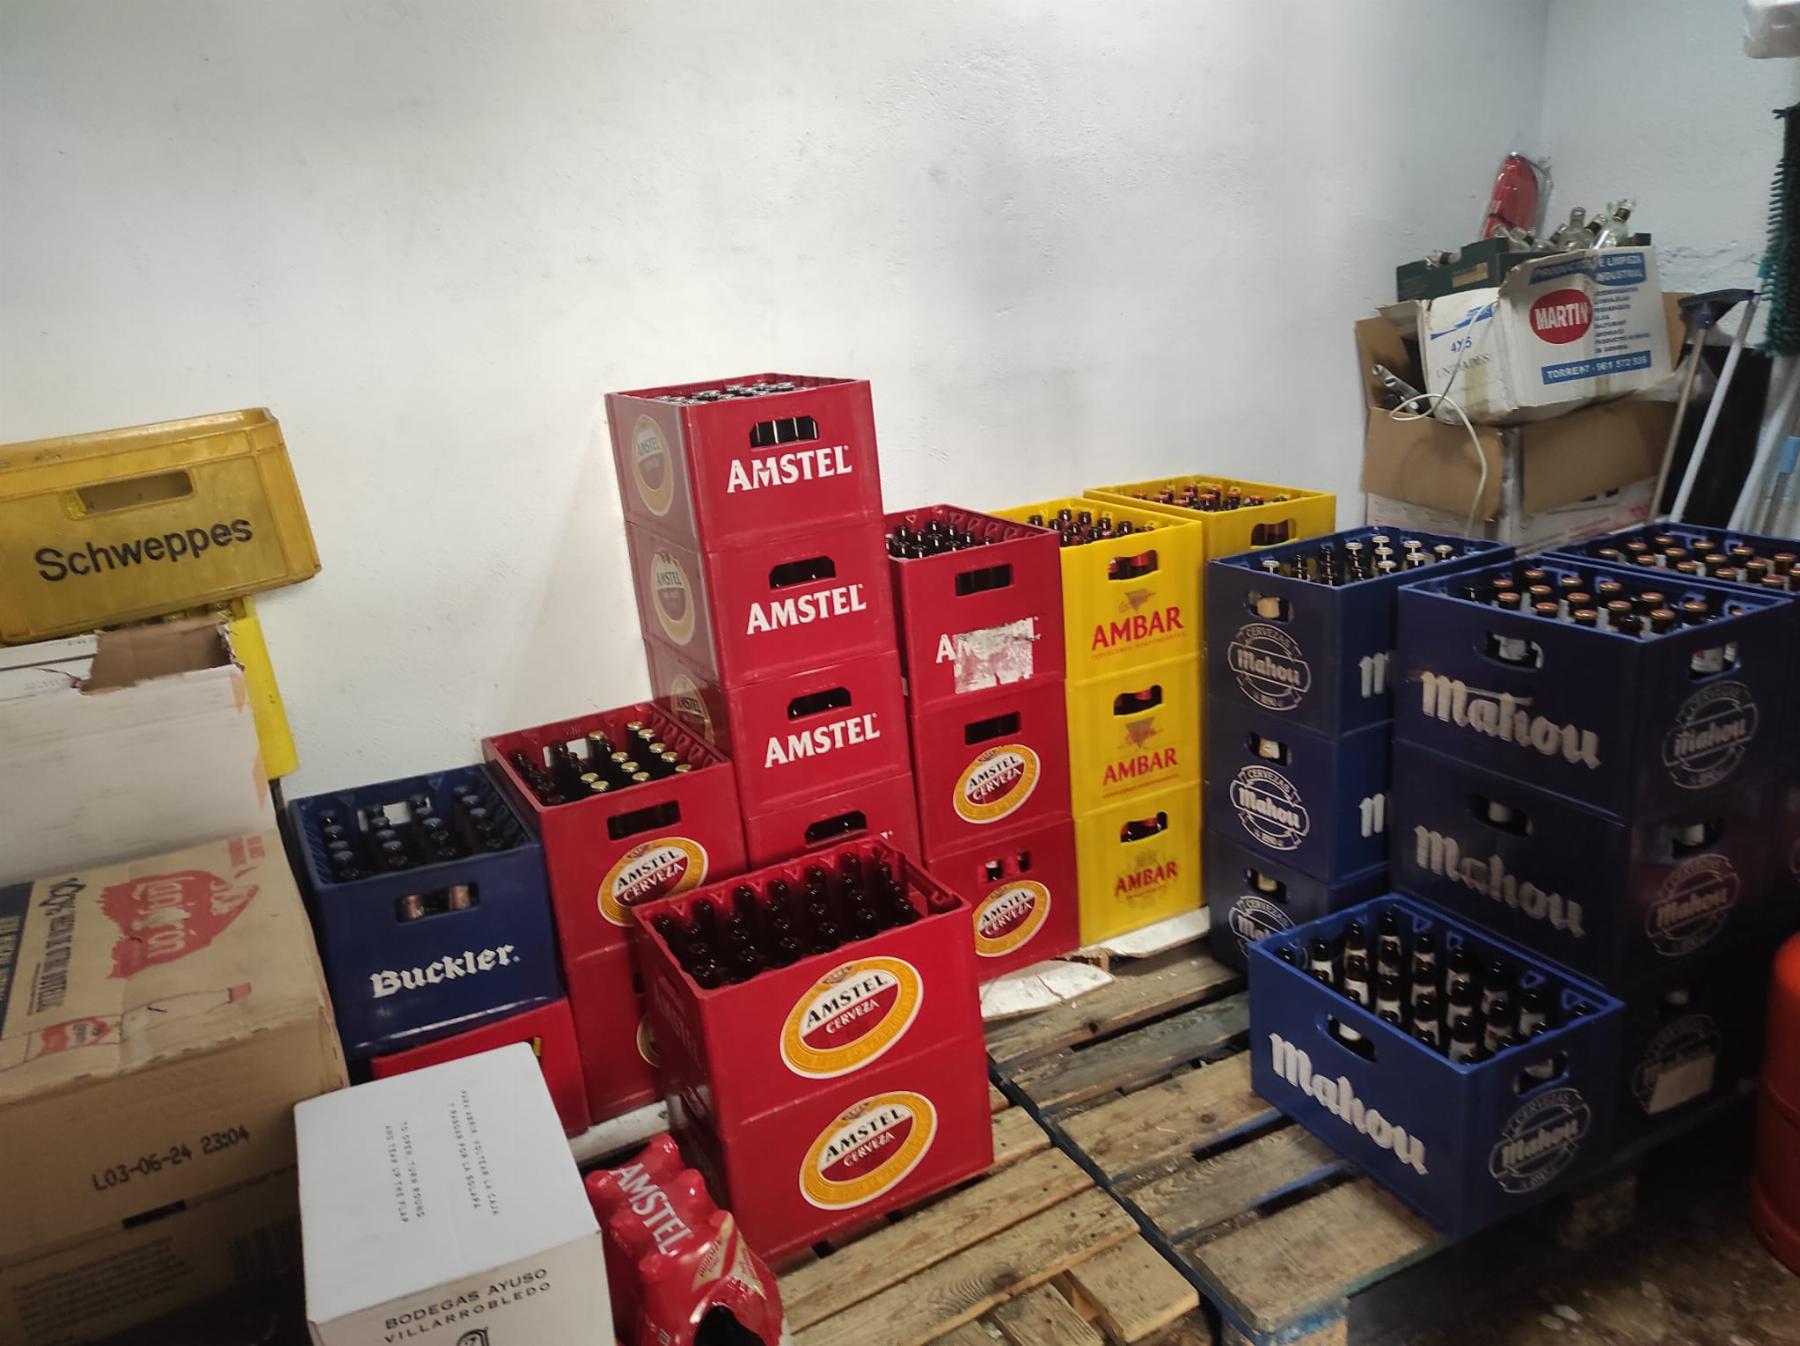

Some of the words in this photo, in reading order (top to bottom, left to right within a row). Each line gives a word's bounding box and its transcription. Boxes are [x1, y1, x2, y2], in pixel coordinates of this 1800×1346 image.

[727, 446, 852, 494] AMSTEL
[35, 517, 253, 582] Schweppes
[747, 584, 867, 635] AMSTEL
[1091, 606, 1184, 652] AMBAR
[1237, 648, 1301, 686] Mahou
[764, 713, 880, 767] AMSTEL
[1420, 671, 1601, 769] Mahou
[969, 755, 1018, 790] AMSTEL
[972, 767, 1023, 801] CERVEZA
[1103, 747, 1179, 787] AMBAR
[1238, 786, 1300, 830] Mahou
[617, 850, 679, 891] AMSTEL
[622, 862, 685, 902] CERVEZA
[1114, 860, 1178, 896] AMBAR
[1414, 824, 1586, 938] Mahou
[806, 974, 890, 1030] AMSTEL
[825, 998, 880, 1035] CERVEZA
[1268, 1032, 1429, 1175] Mahou
[92, 1143, 194, 1192] L03-06-24
[200, 1124, 250, 1155] 23:04
[824, 1106, 906, 1161] AMSTEL
[843, 1130, 897, 1167] CERVEZA
[1501, 1118, 1579, 1168] Mahou
[607, 1162, 693, 1258] AMSTEL
[384, 1290, 481, 1330] BODEGAS
[487, 1268, 548, 1297] AYUSO
[384, 1282, 551, 1344] VILLARROBLEDO
